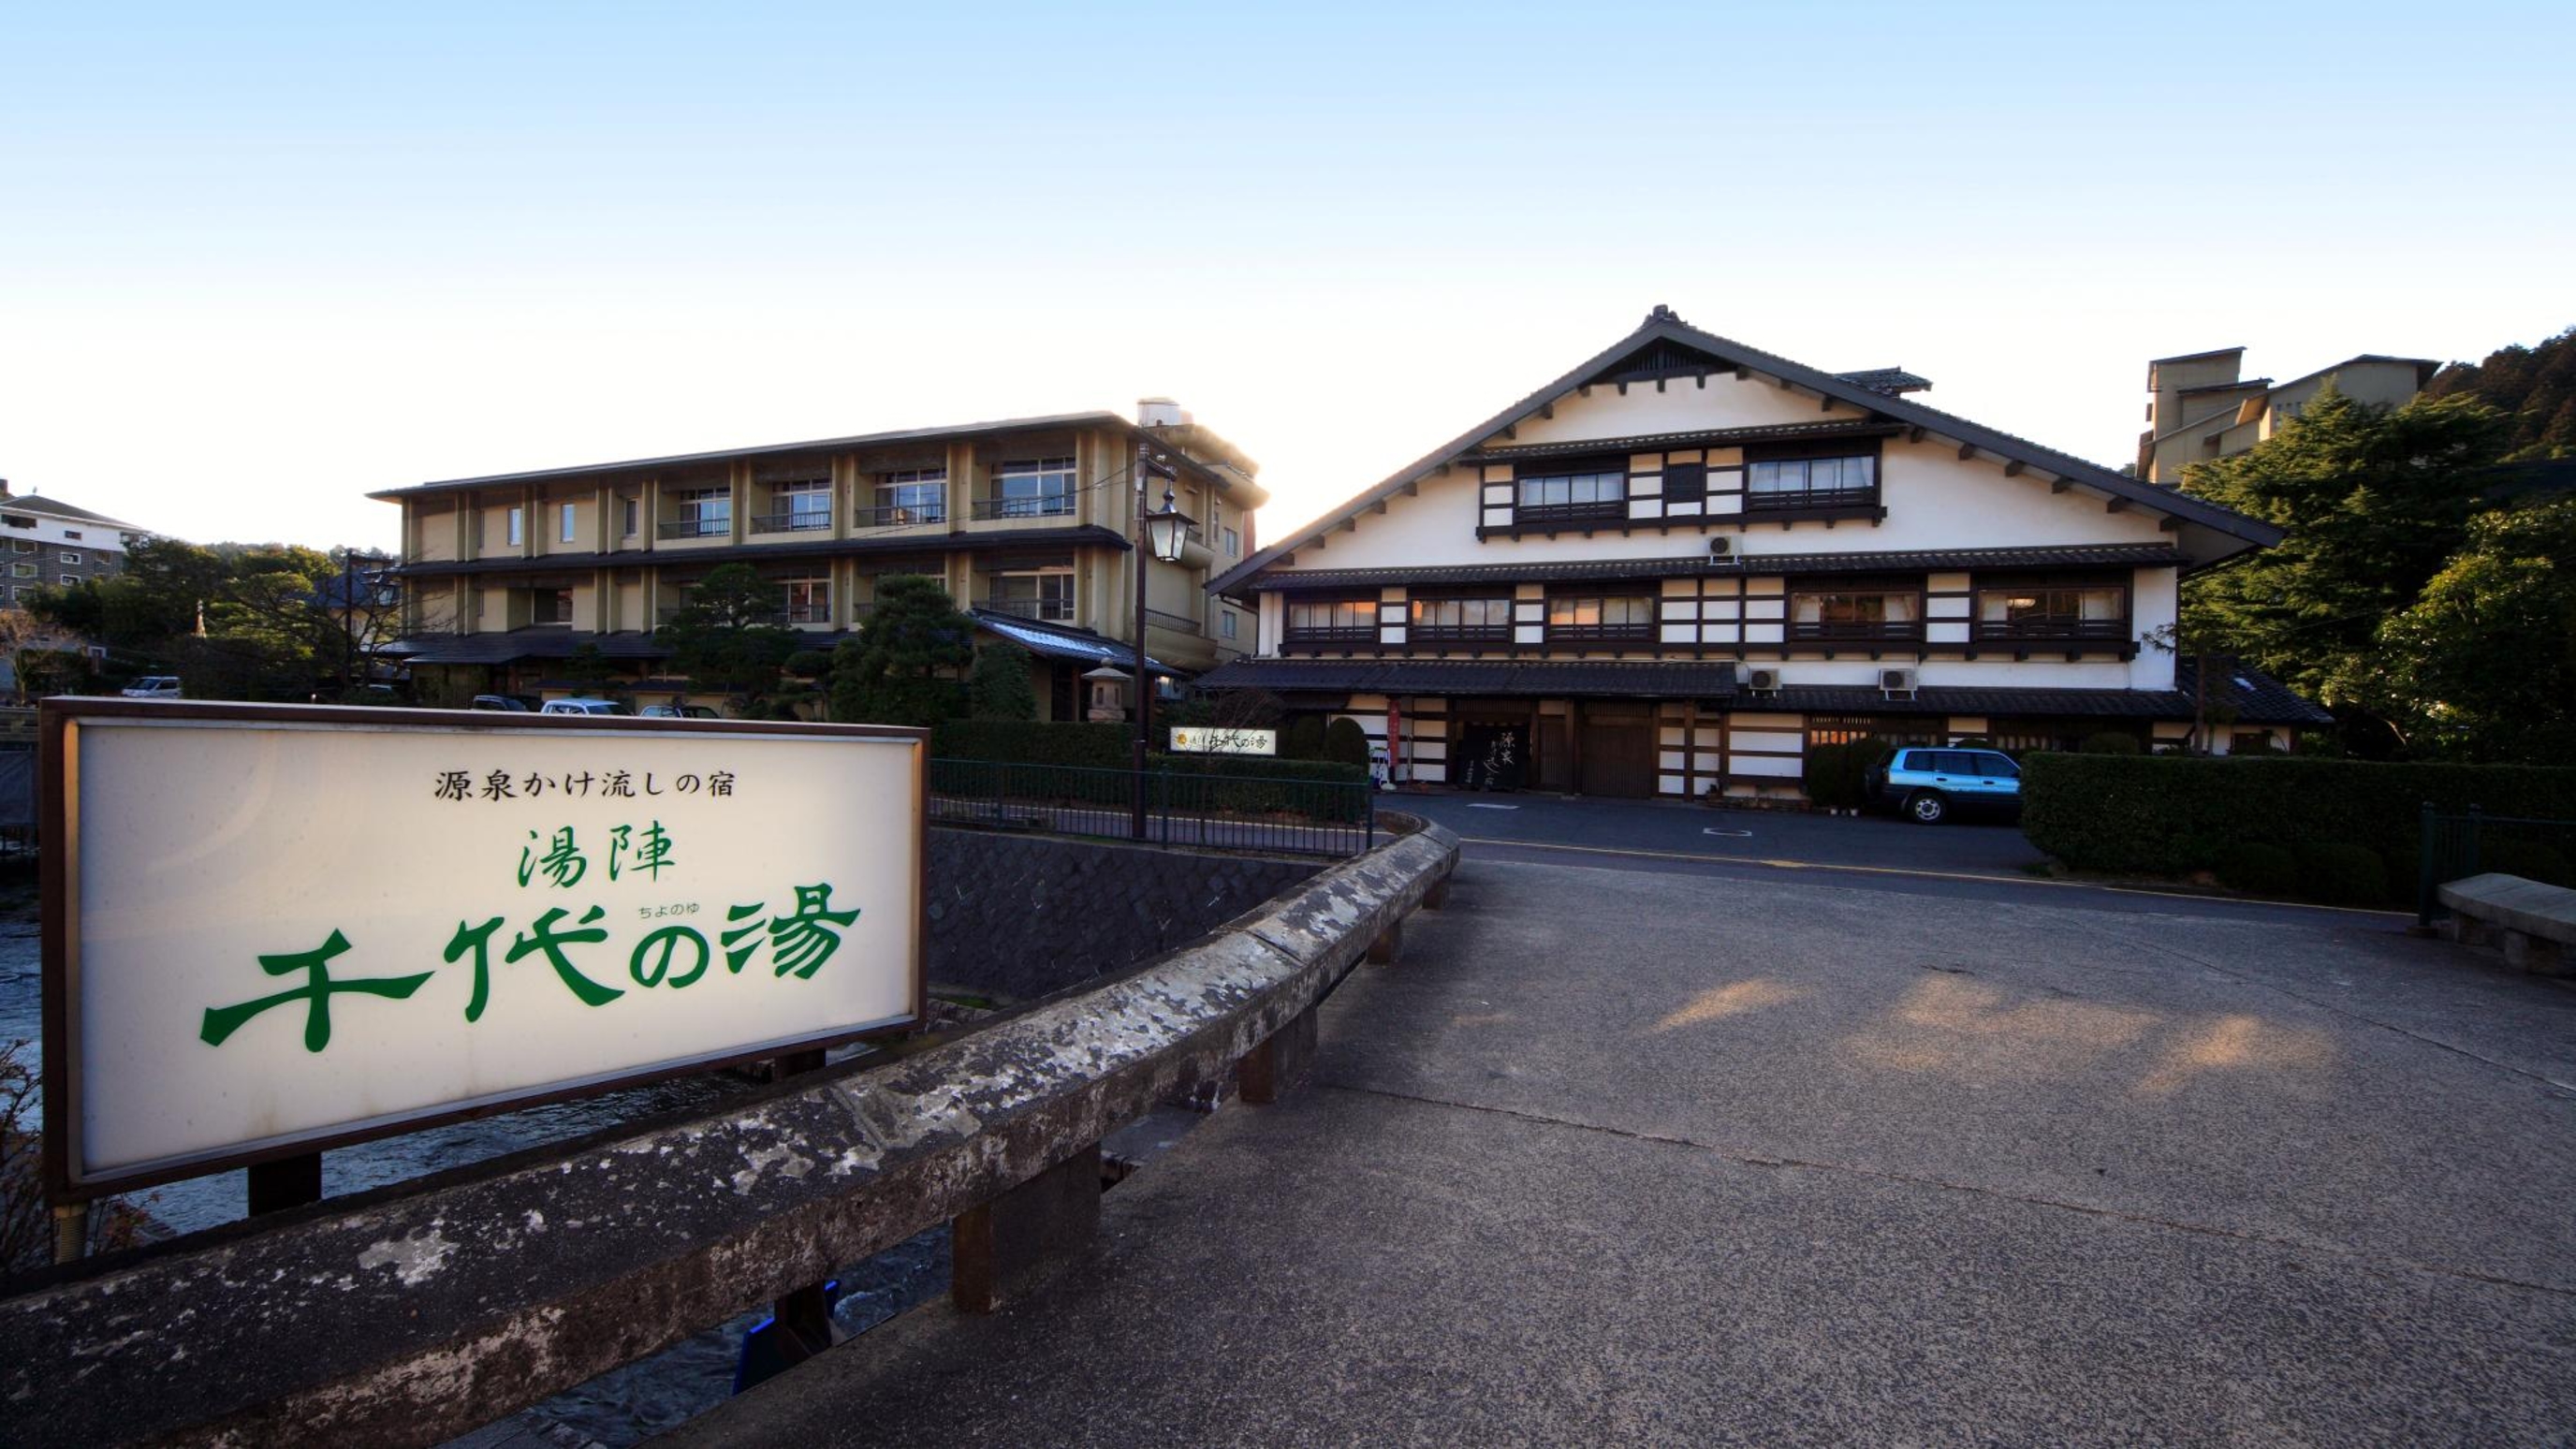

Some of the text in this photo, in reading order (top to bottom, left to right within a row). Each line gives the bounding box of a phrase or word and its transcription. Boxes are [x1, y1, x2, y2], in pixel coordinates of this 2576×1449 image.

[434, 768, 736, 802] 源泉かけ流しの宿
[518, 820, 676, 888] 湯陣
[638, 902, 700, 919] ちよのゆ
[199, 883, 861, 1053] 千代の湯
